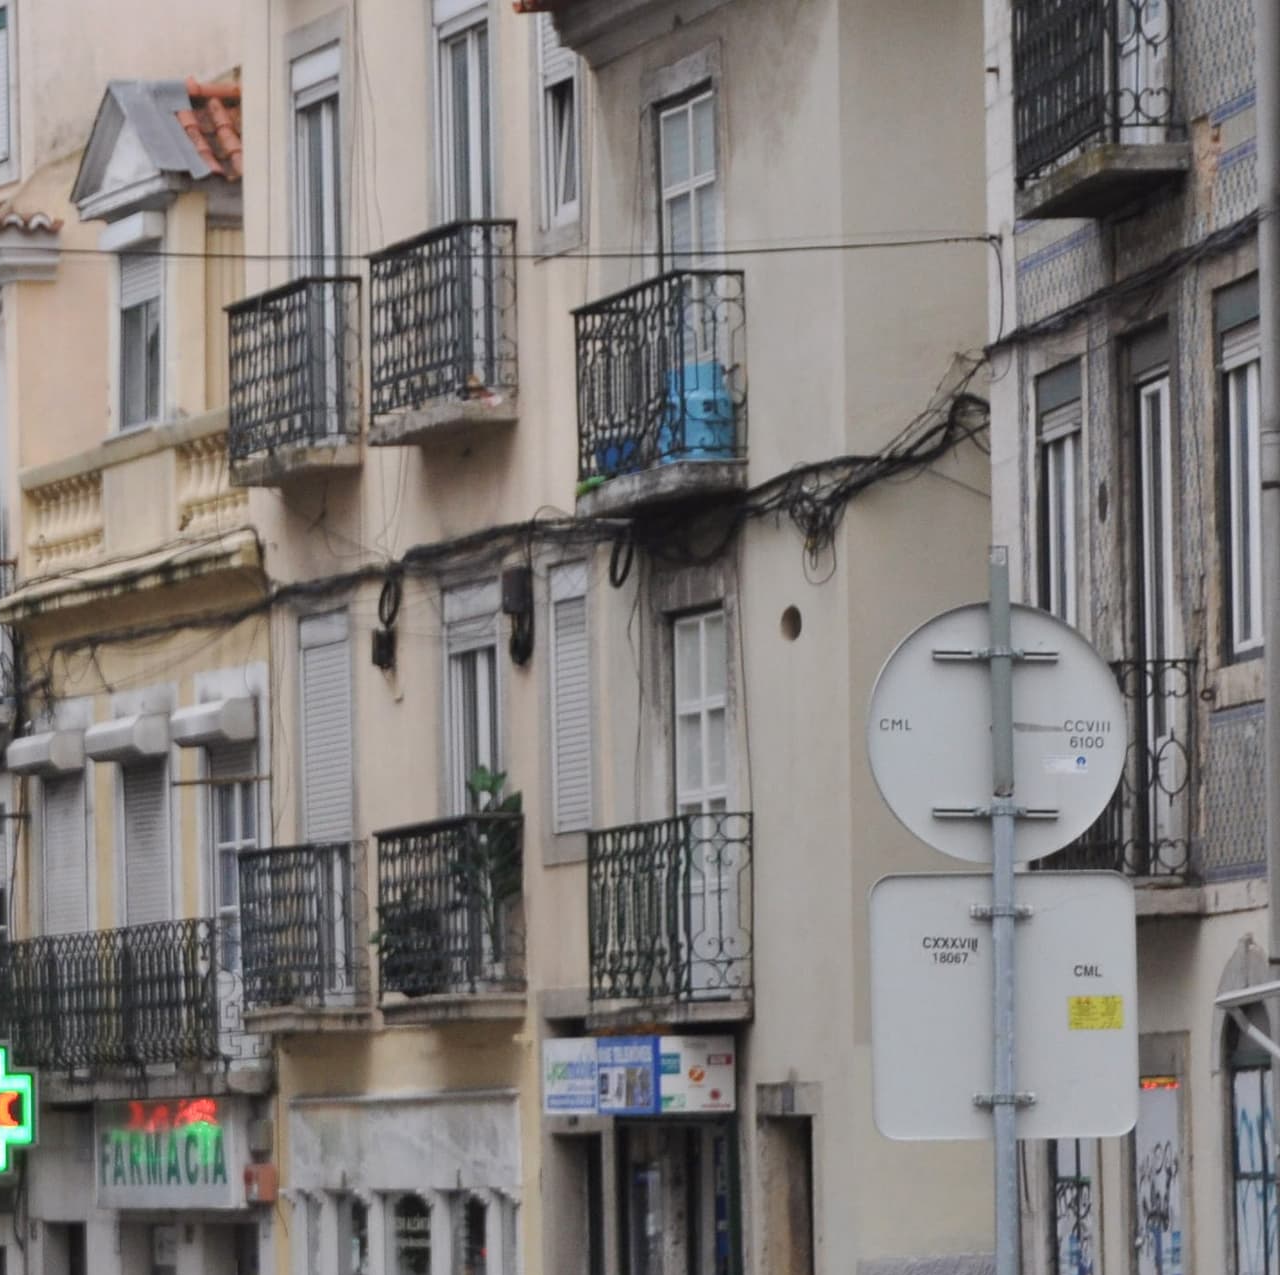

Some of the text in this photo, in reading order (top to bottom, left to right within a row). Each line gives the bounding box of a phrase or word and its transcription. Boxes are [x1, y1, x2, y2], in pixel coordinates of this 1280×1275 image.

[879, 718, 912, 731] CML
[1063, 719, 1111, 733] CCVIII
[1069, 736, 1104, 748] 6100
[1073, 965, 1103, 977] CML
